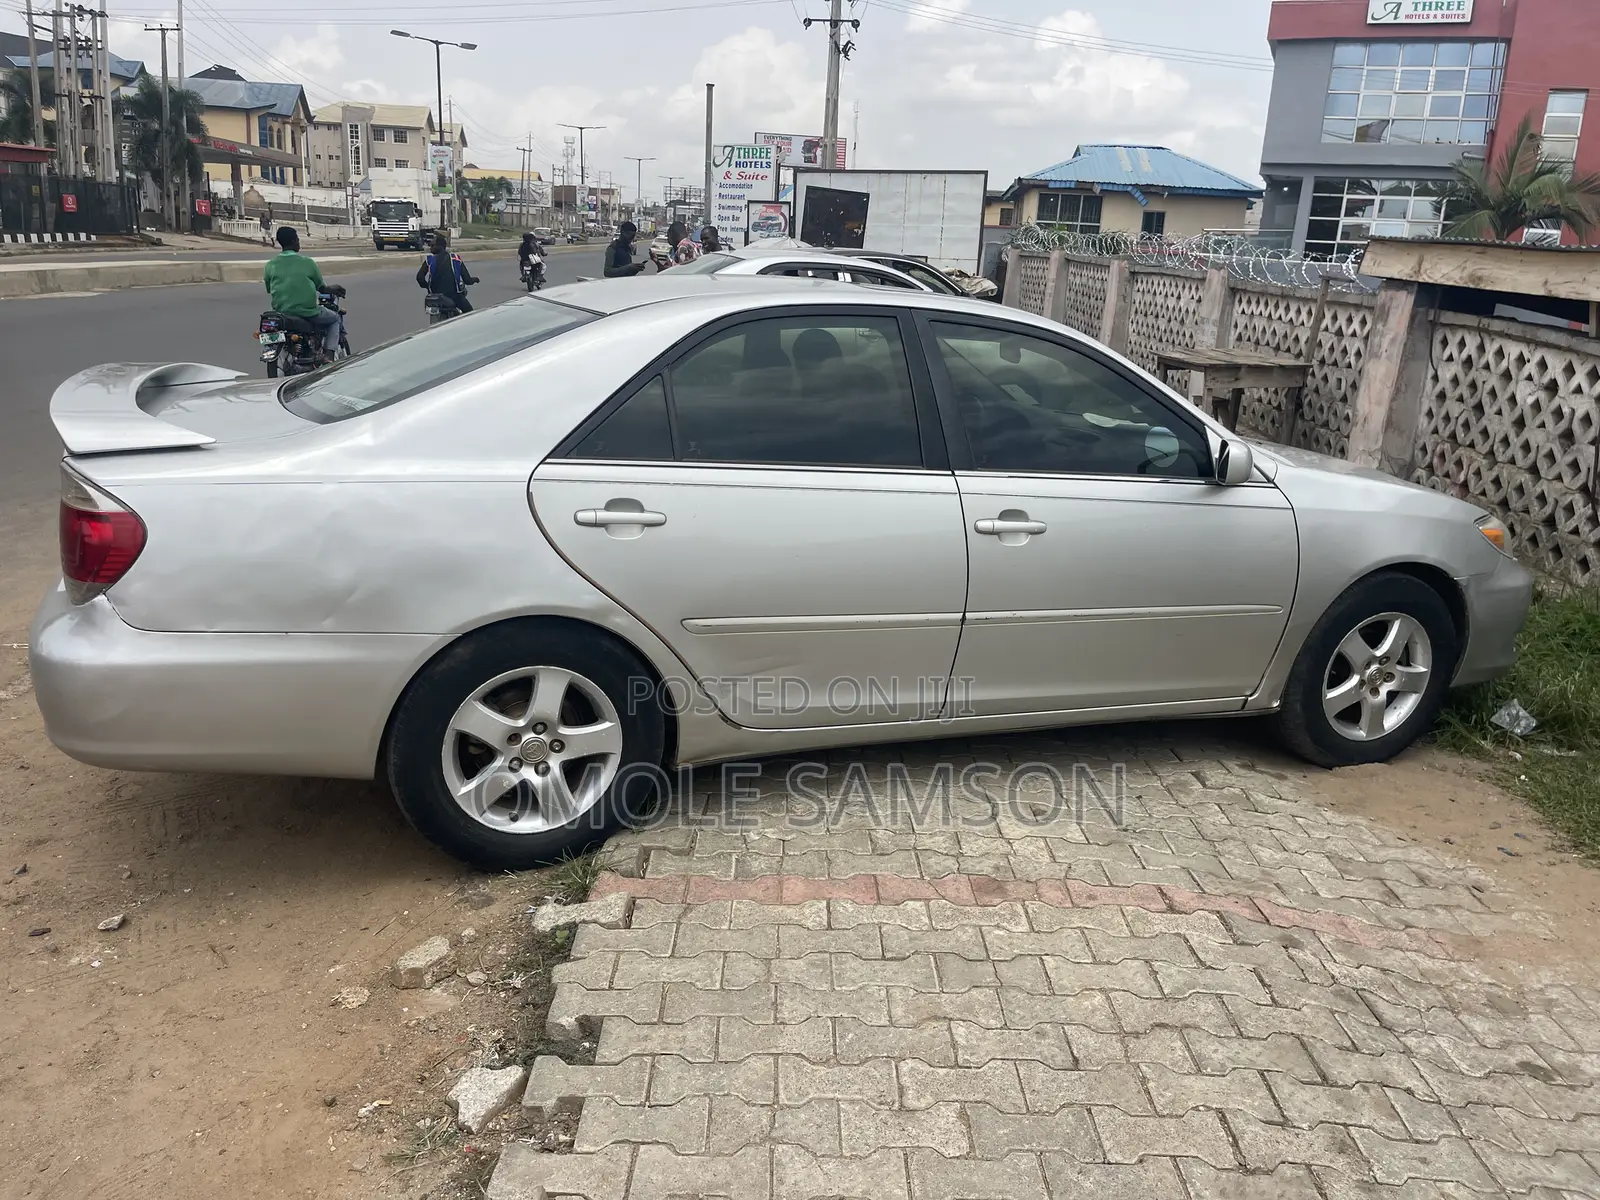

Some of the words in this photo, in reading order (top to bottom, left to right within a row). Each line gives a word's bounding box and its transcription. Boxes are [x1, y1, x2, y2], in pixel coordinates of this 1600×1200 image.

[1371, 1, 1402, 21] A
[1412, 1, 1465, 11] THREE
[713, 145, 735, 168] A
[736, 147, 771, 159] THREE
[723, 171, 732, 180] &
[736, 171, 768, 180] Suite
[718, 204, 742, 212] Swimming
